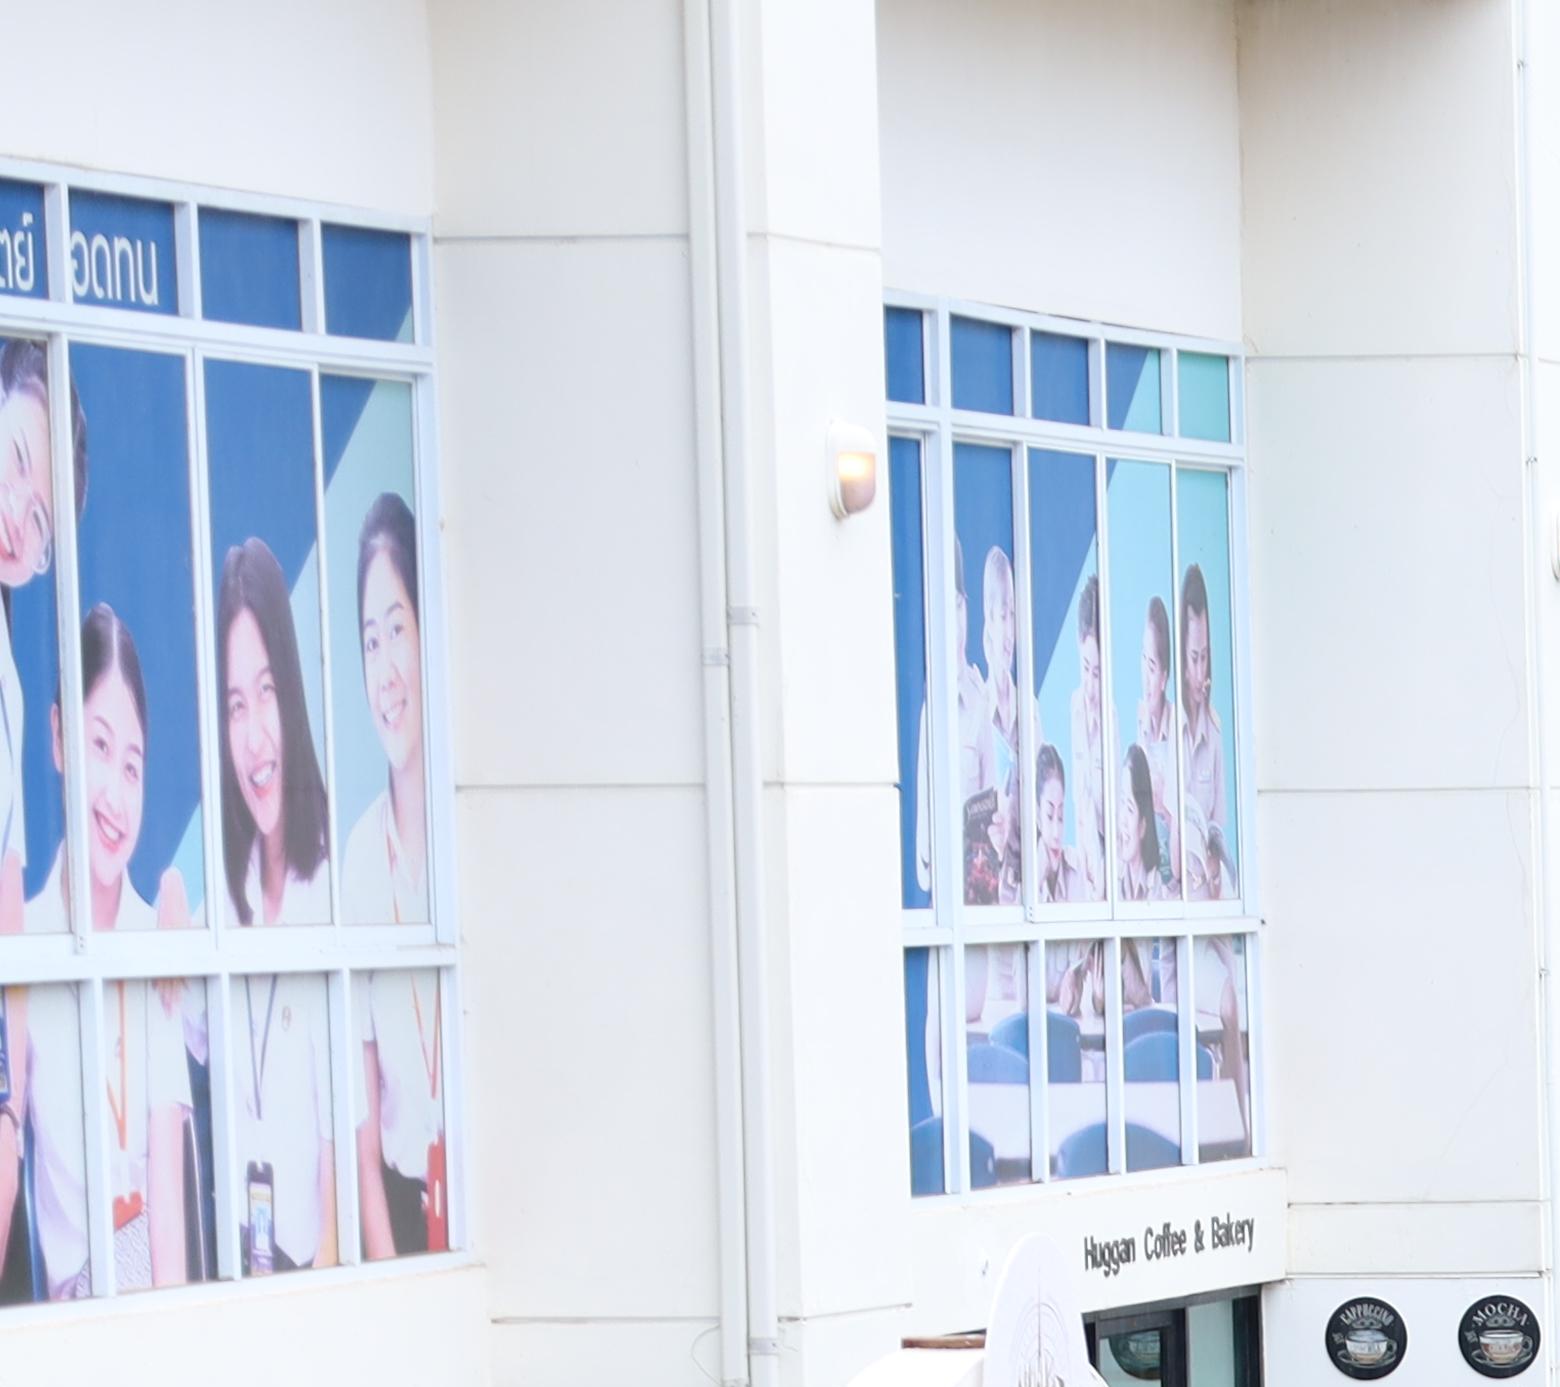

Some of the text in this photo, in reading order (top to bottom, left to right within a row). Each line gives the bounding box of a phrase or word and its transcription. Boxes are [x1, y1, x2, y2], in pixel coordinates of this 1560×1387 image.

[71, 230, 159, 305] อดทน
[1084, 1212, 1254, 1277] Huggan Coffee & Bakery
[1472, 1302, 1528, 1326] MOCHA
